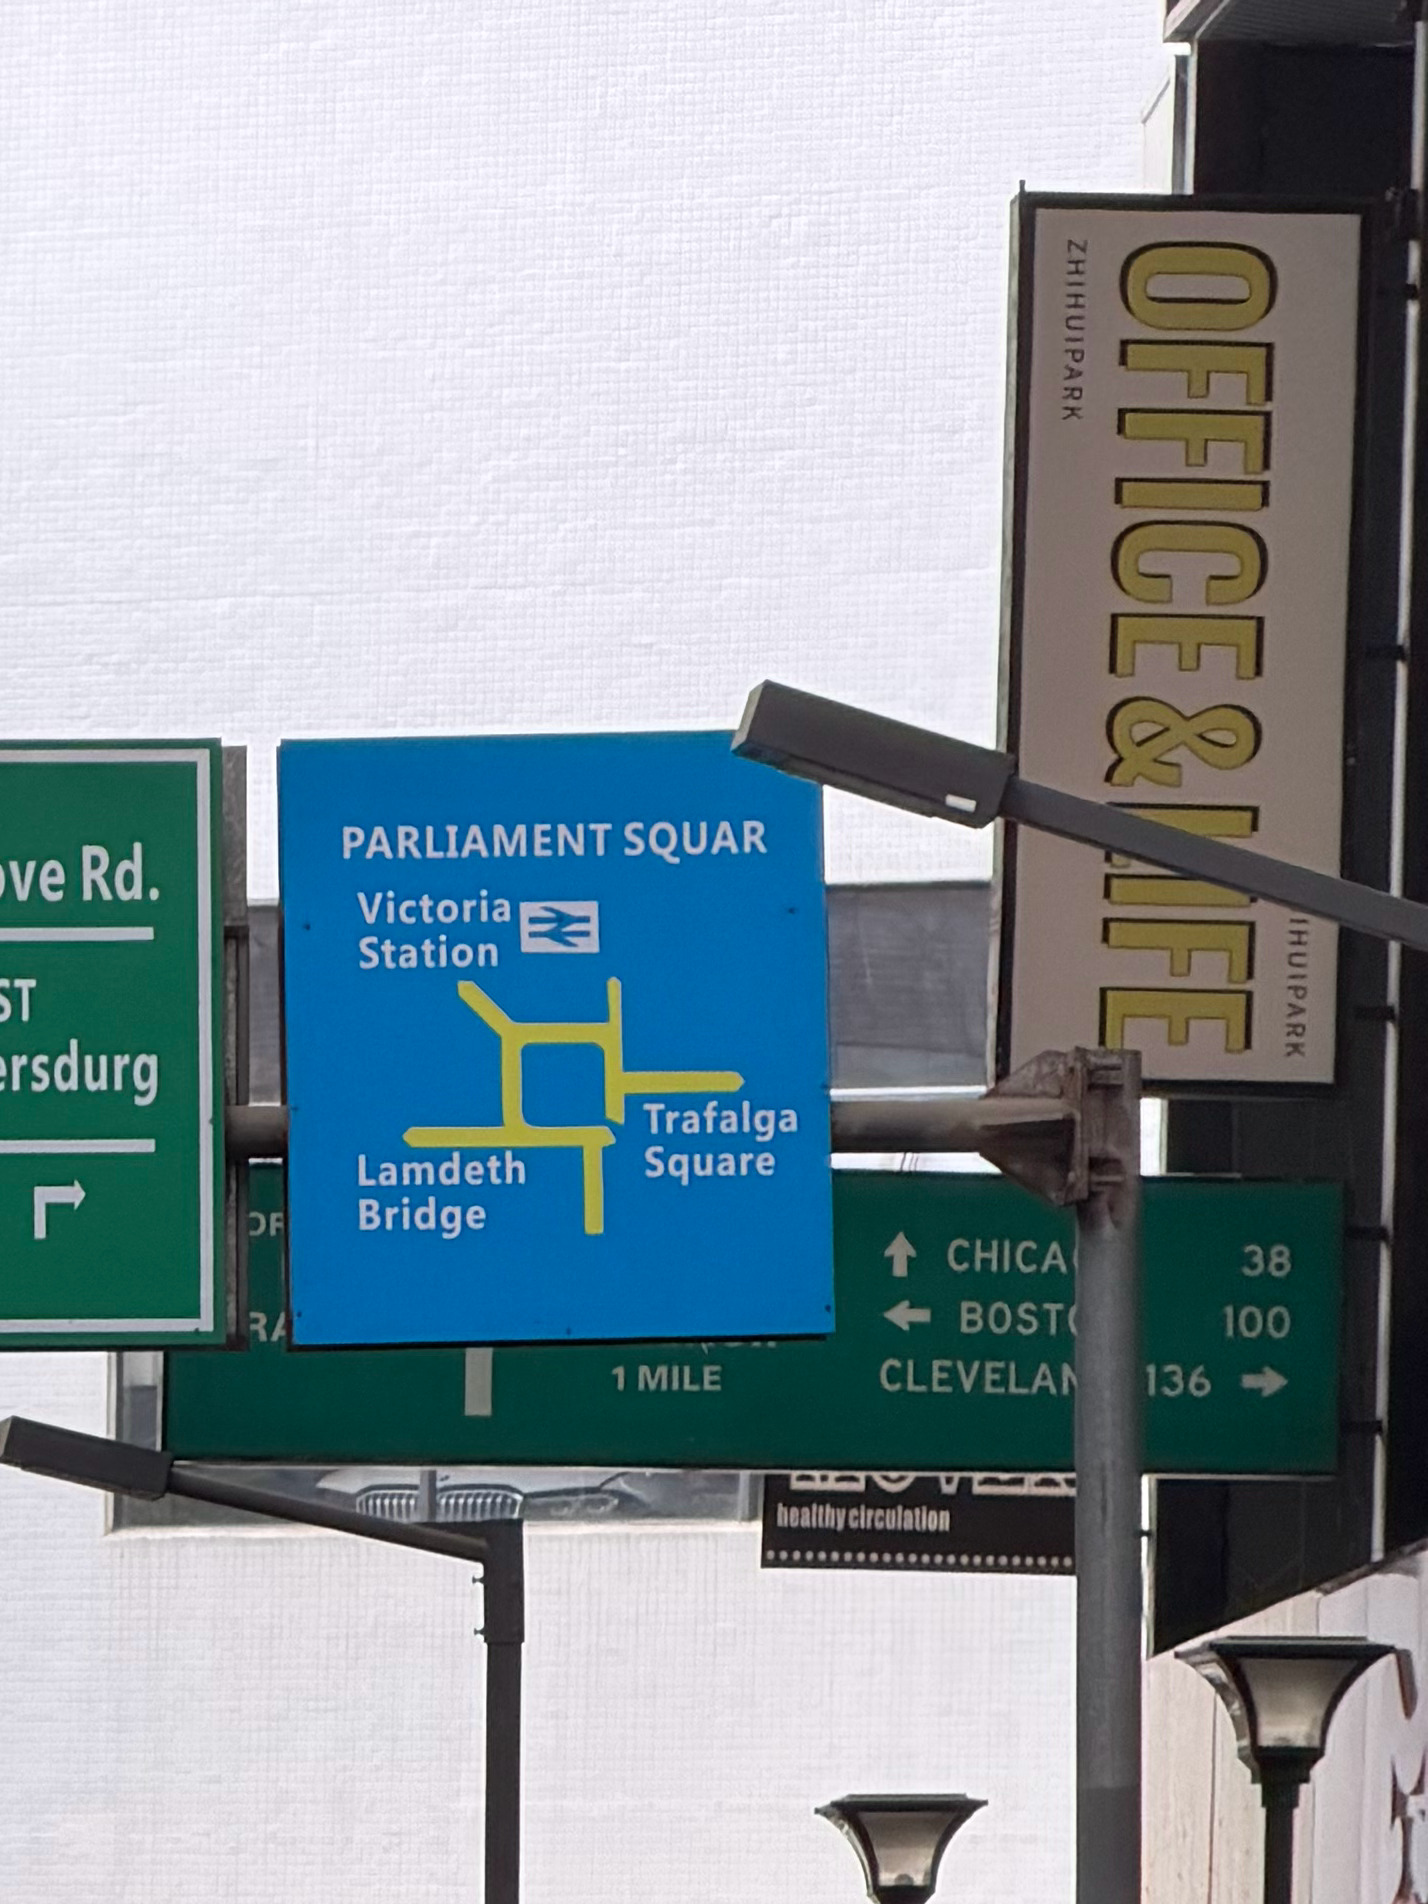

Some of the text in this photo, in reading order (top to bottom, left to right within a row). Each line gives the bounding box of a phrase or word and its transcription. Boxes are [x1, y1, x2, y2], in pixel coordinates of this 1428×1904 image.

[1061, 239, 1088, 421] ZHIHUIPARK
[342, 820, 768, 864] PARLIAMENT SQUAR
[80, 841, 161, 902] Rd.
[357, 889, 512, 924] Victoria
[358, 935, 500, 969] Station
[643, 1100, 799, 1141] Trafalga
[357, 1150, 527, 1187] Lamdeth
[644, 1146, 776, 1186] Square
[358, 1197, 488, 1240] Bridge
[947, 1238, 1078, 1275] CHICA
[1241, 1244, 1293, 1278] 38
[1222, 1305, 1293, 1339] 100
[611, 1364, 723, 1392] 1 MILE
[1146, 1364, 1212, 1398] 136
[776, 1502, 951, 1533] healthy circulation
